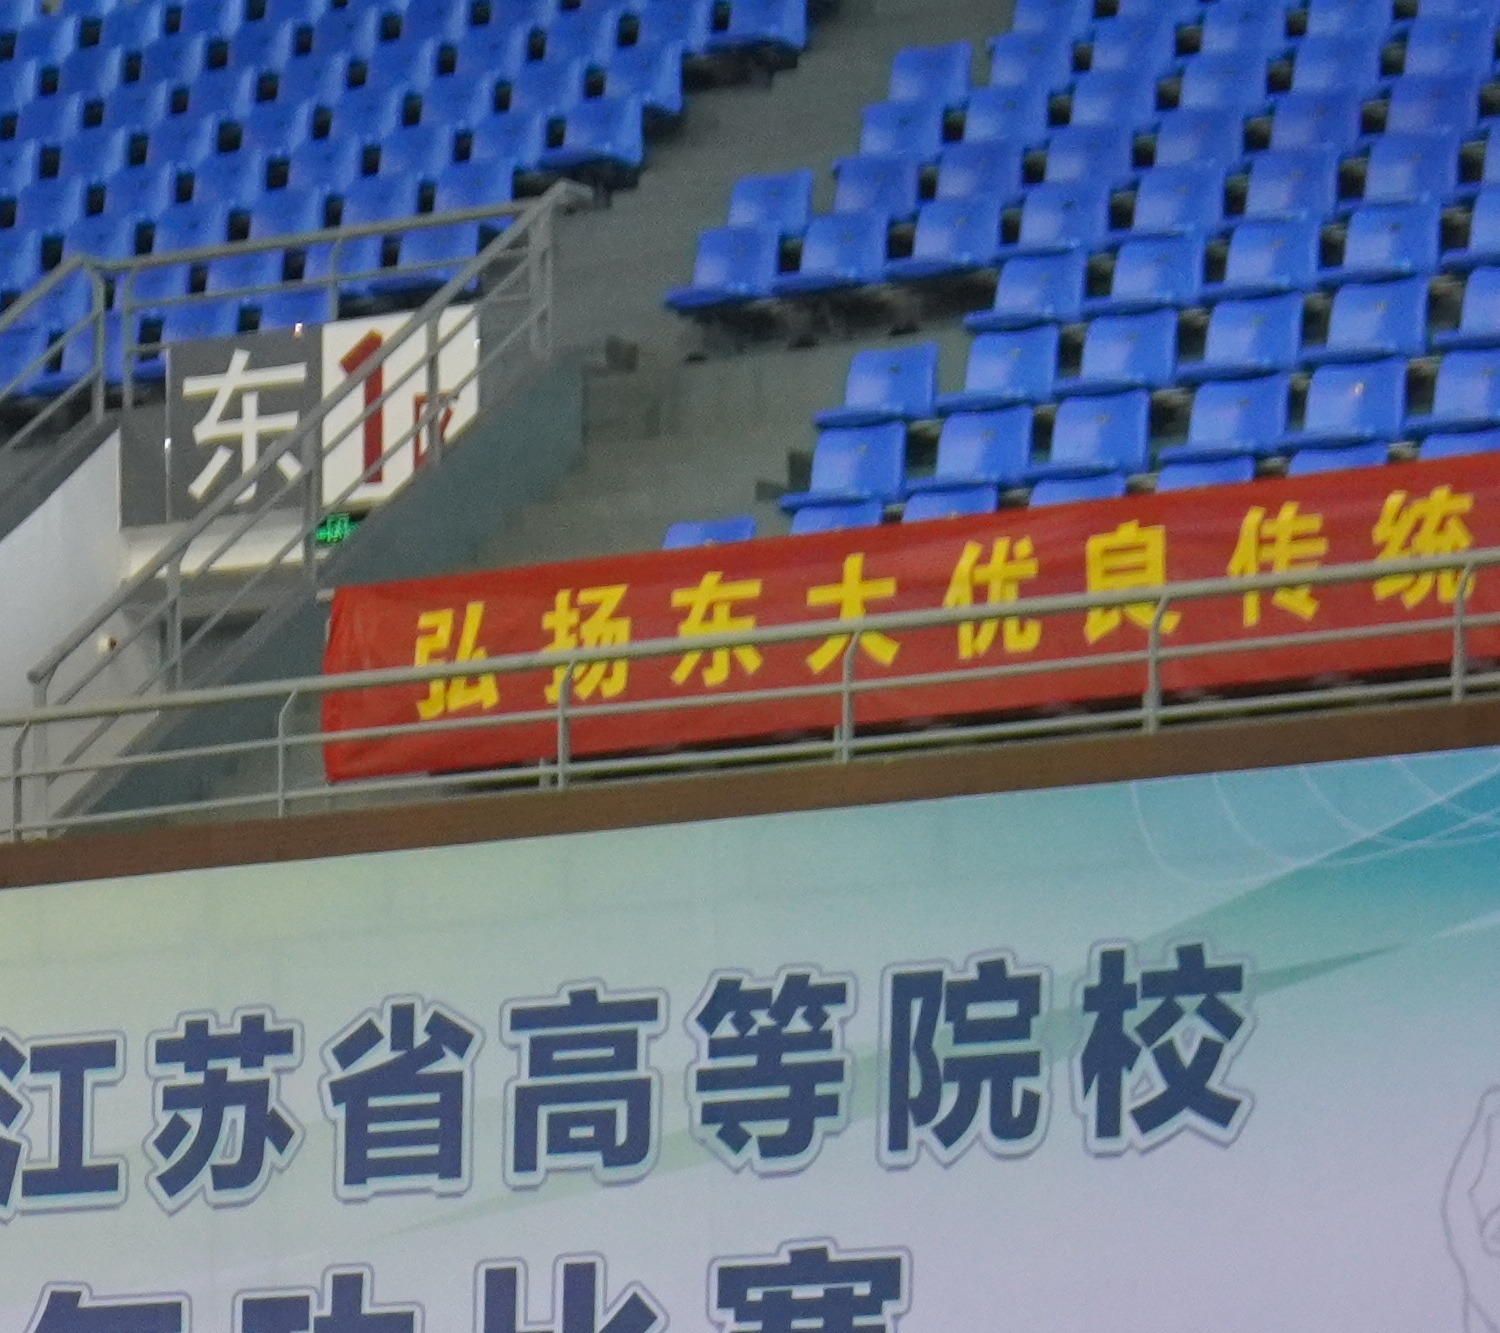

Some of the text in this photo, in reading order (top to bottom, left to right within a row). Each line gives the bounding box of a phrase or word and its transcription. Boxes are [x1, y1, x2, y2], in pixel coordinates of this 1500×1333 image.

[413, 483, 1476, 721] 弘扬东大优良传统
